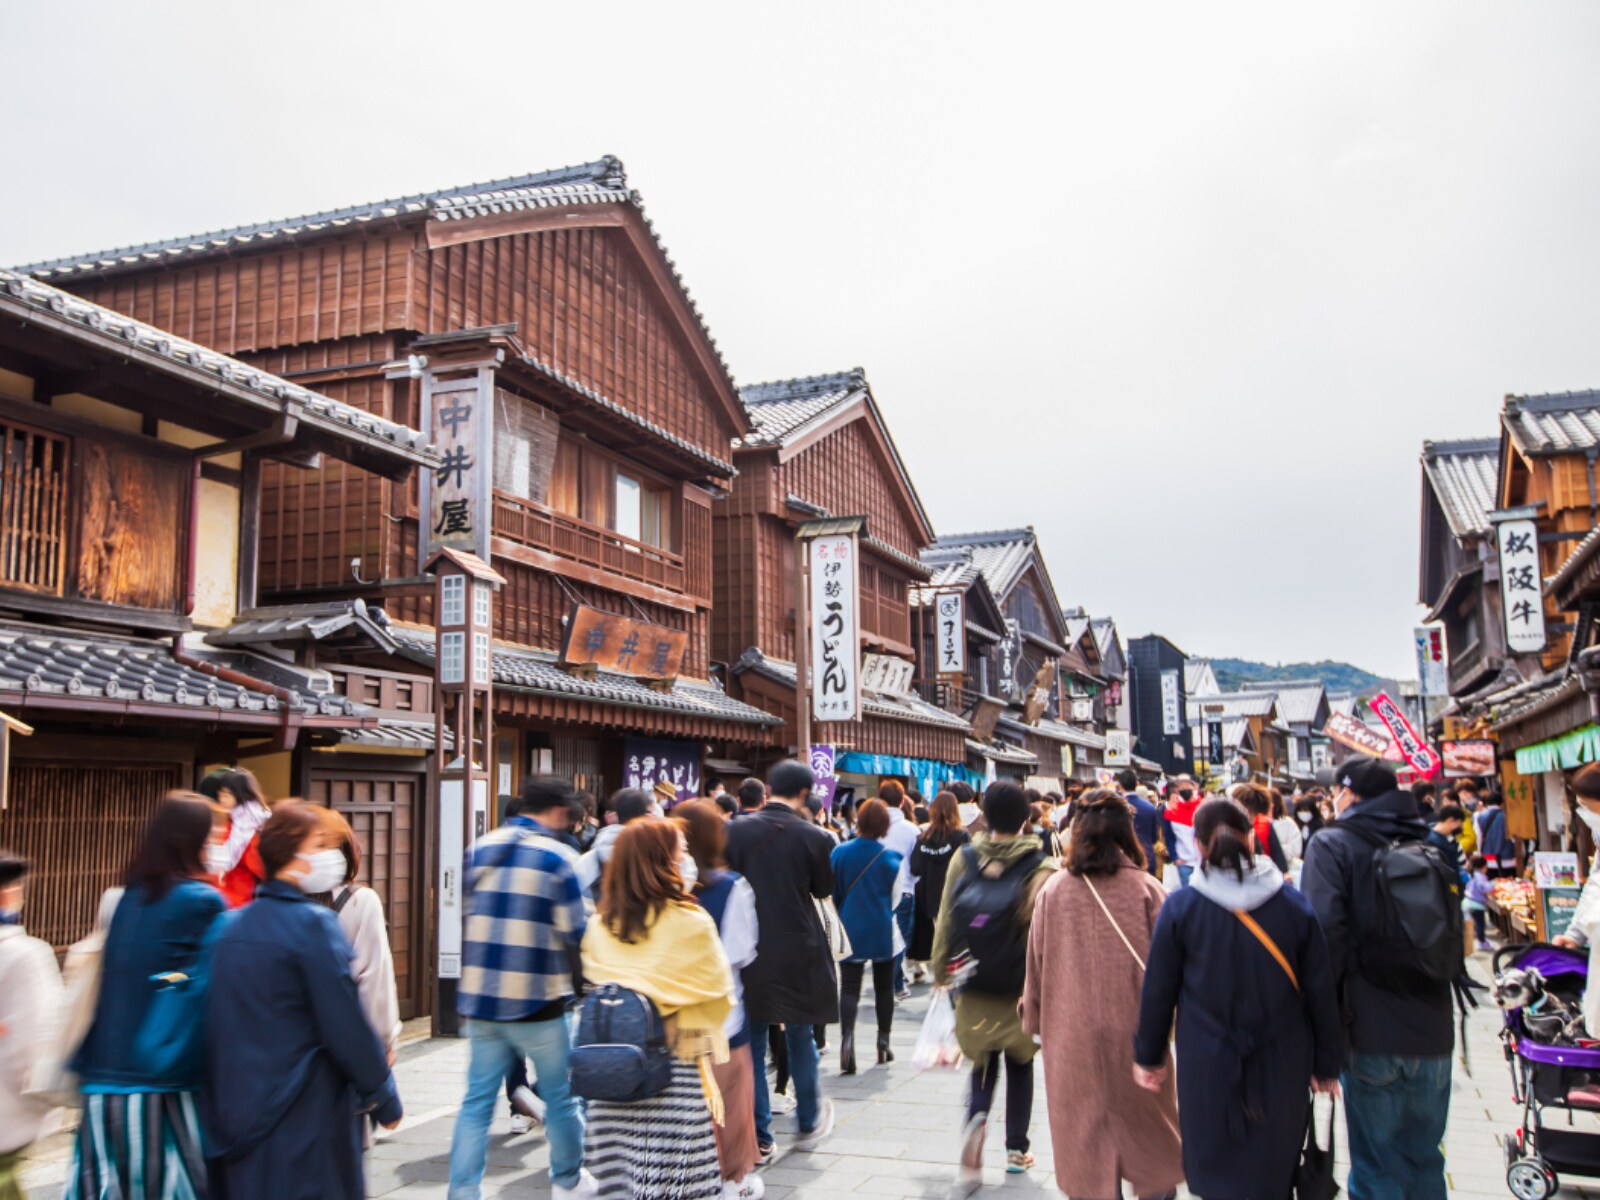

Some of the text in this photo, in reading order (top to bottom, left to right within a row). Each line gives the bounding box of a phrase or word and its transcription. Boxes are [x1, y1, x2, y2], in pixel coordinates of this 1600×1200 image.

[434, 397, 473, 536] 中井屋
[816, 541, 848, 559] 名物
[1504, 530, 1538, 625] 松阪牛
[585, 622, 673, 676] 中井屋
[822, 562, 847, 696] 伊勢うどん
[659, 758, 700, 793] うどん
